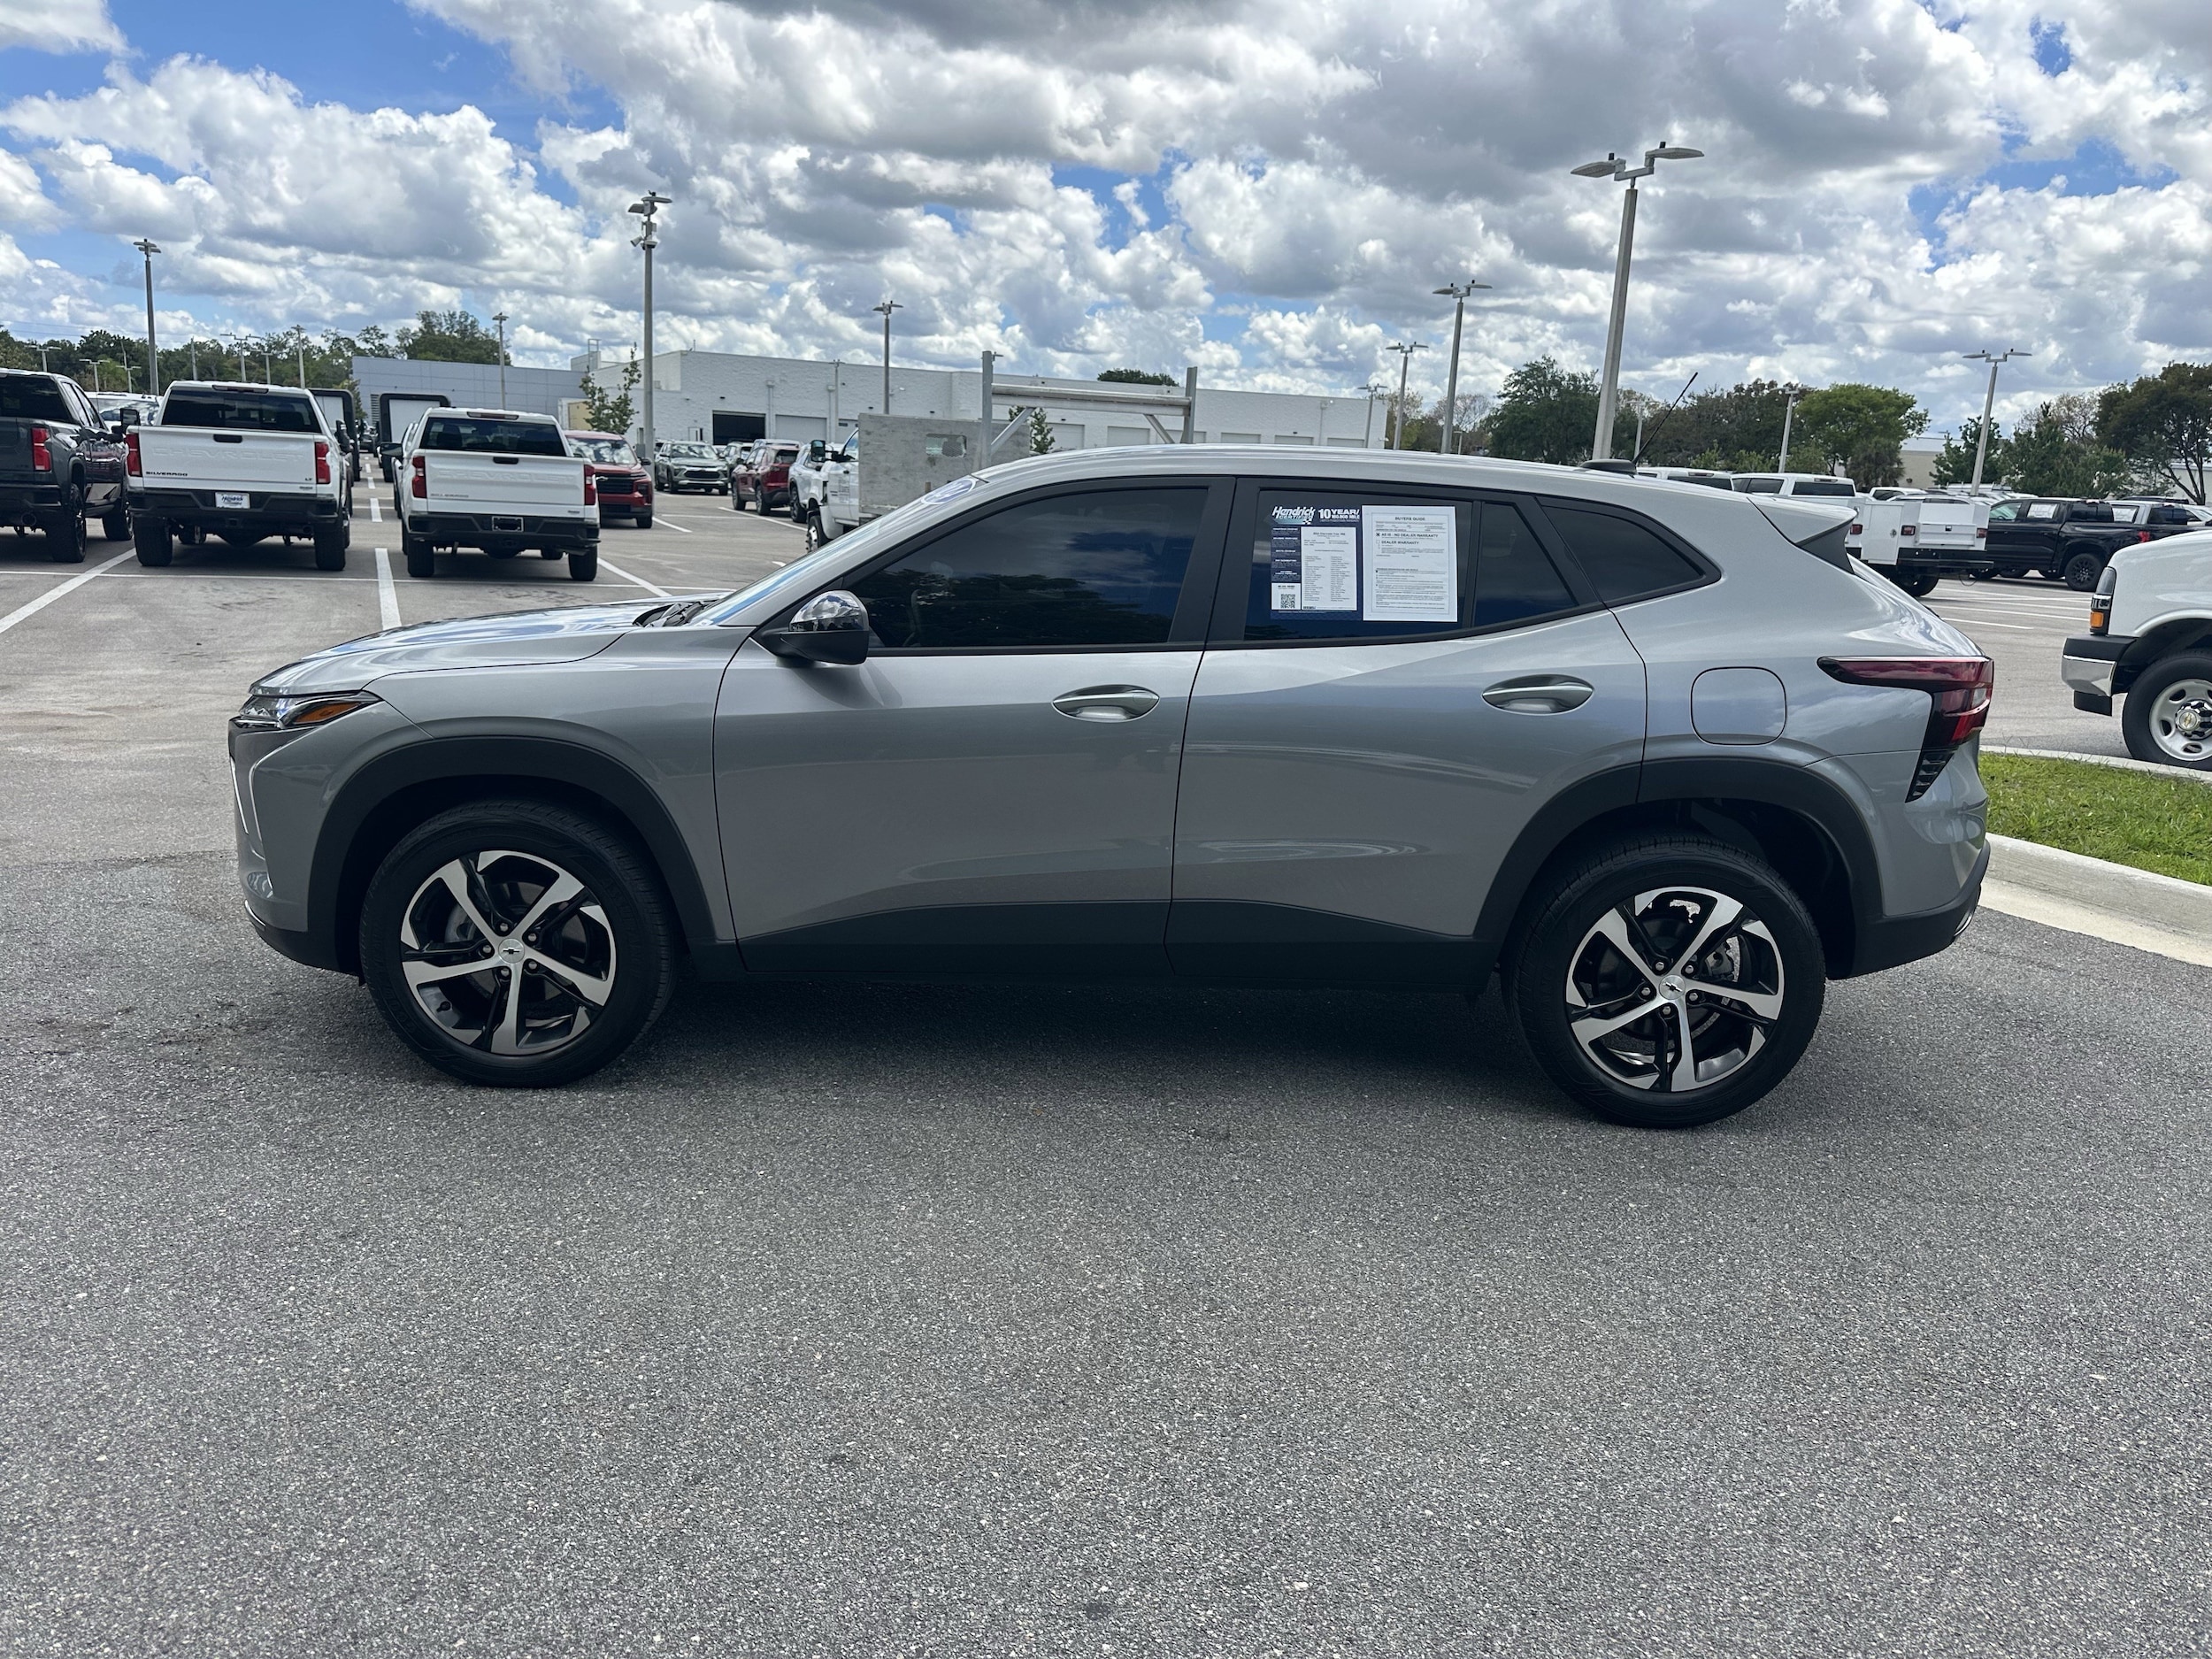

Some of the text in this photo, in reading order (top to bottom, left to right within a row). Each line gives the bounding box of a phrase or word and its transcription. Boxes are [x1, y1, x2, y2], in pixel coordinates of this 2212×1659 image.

[152, 446, 304, 462] CHEVROLET
[438, 469, 575, 484] CHEVROLET
[1271, 506, 1317, 519] Hendrick
[1318, 509, 1331, 519] 10
